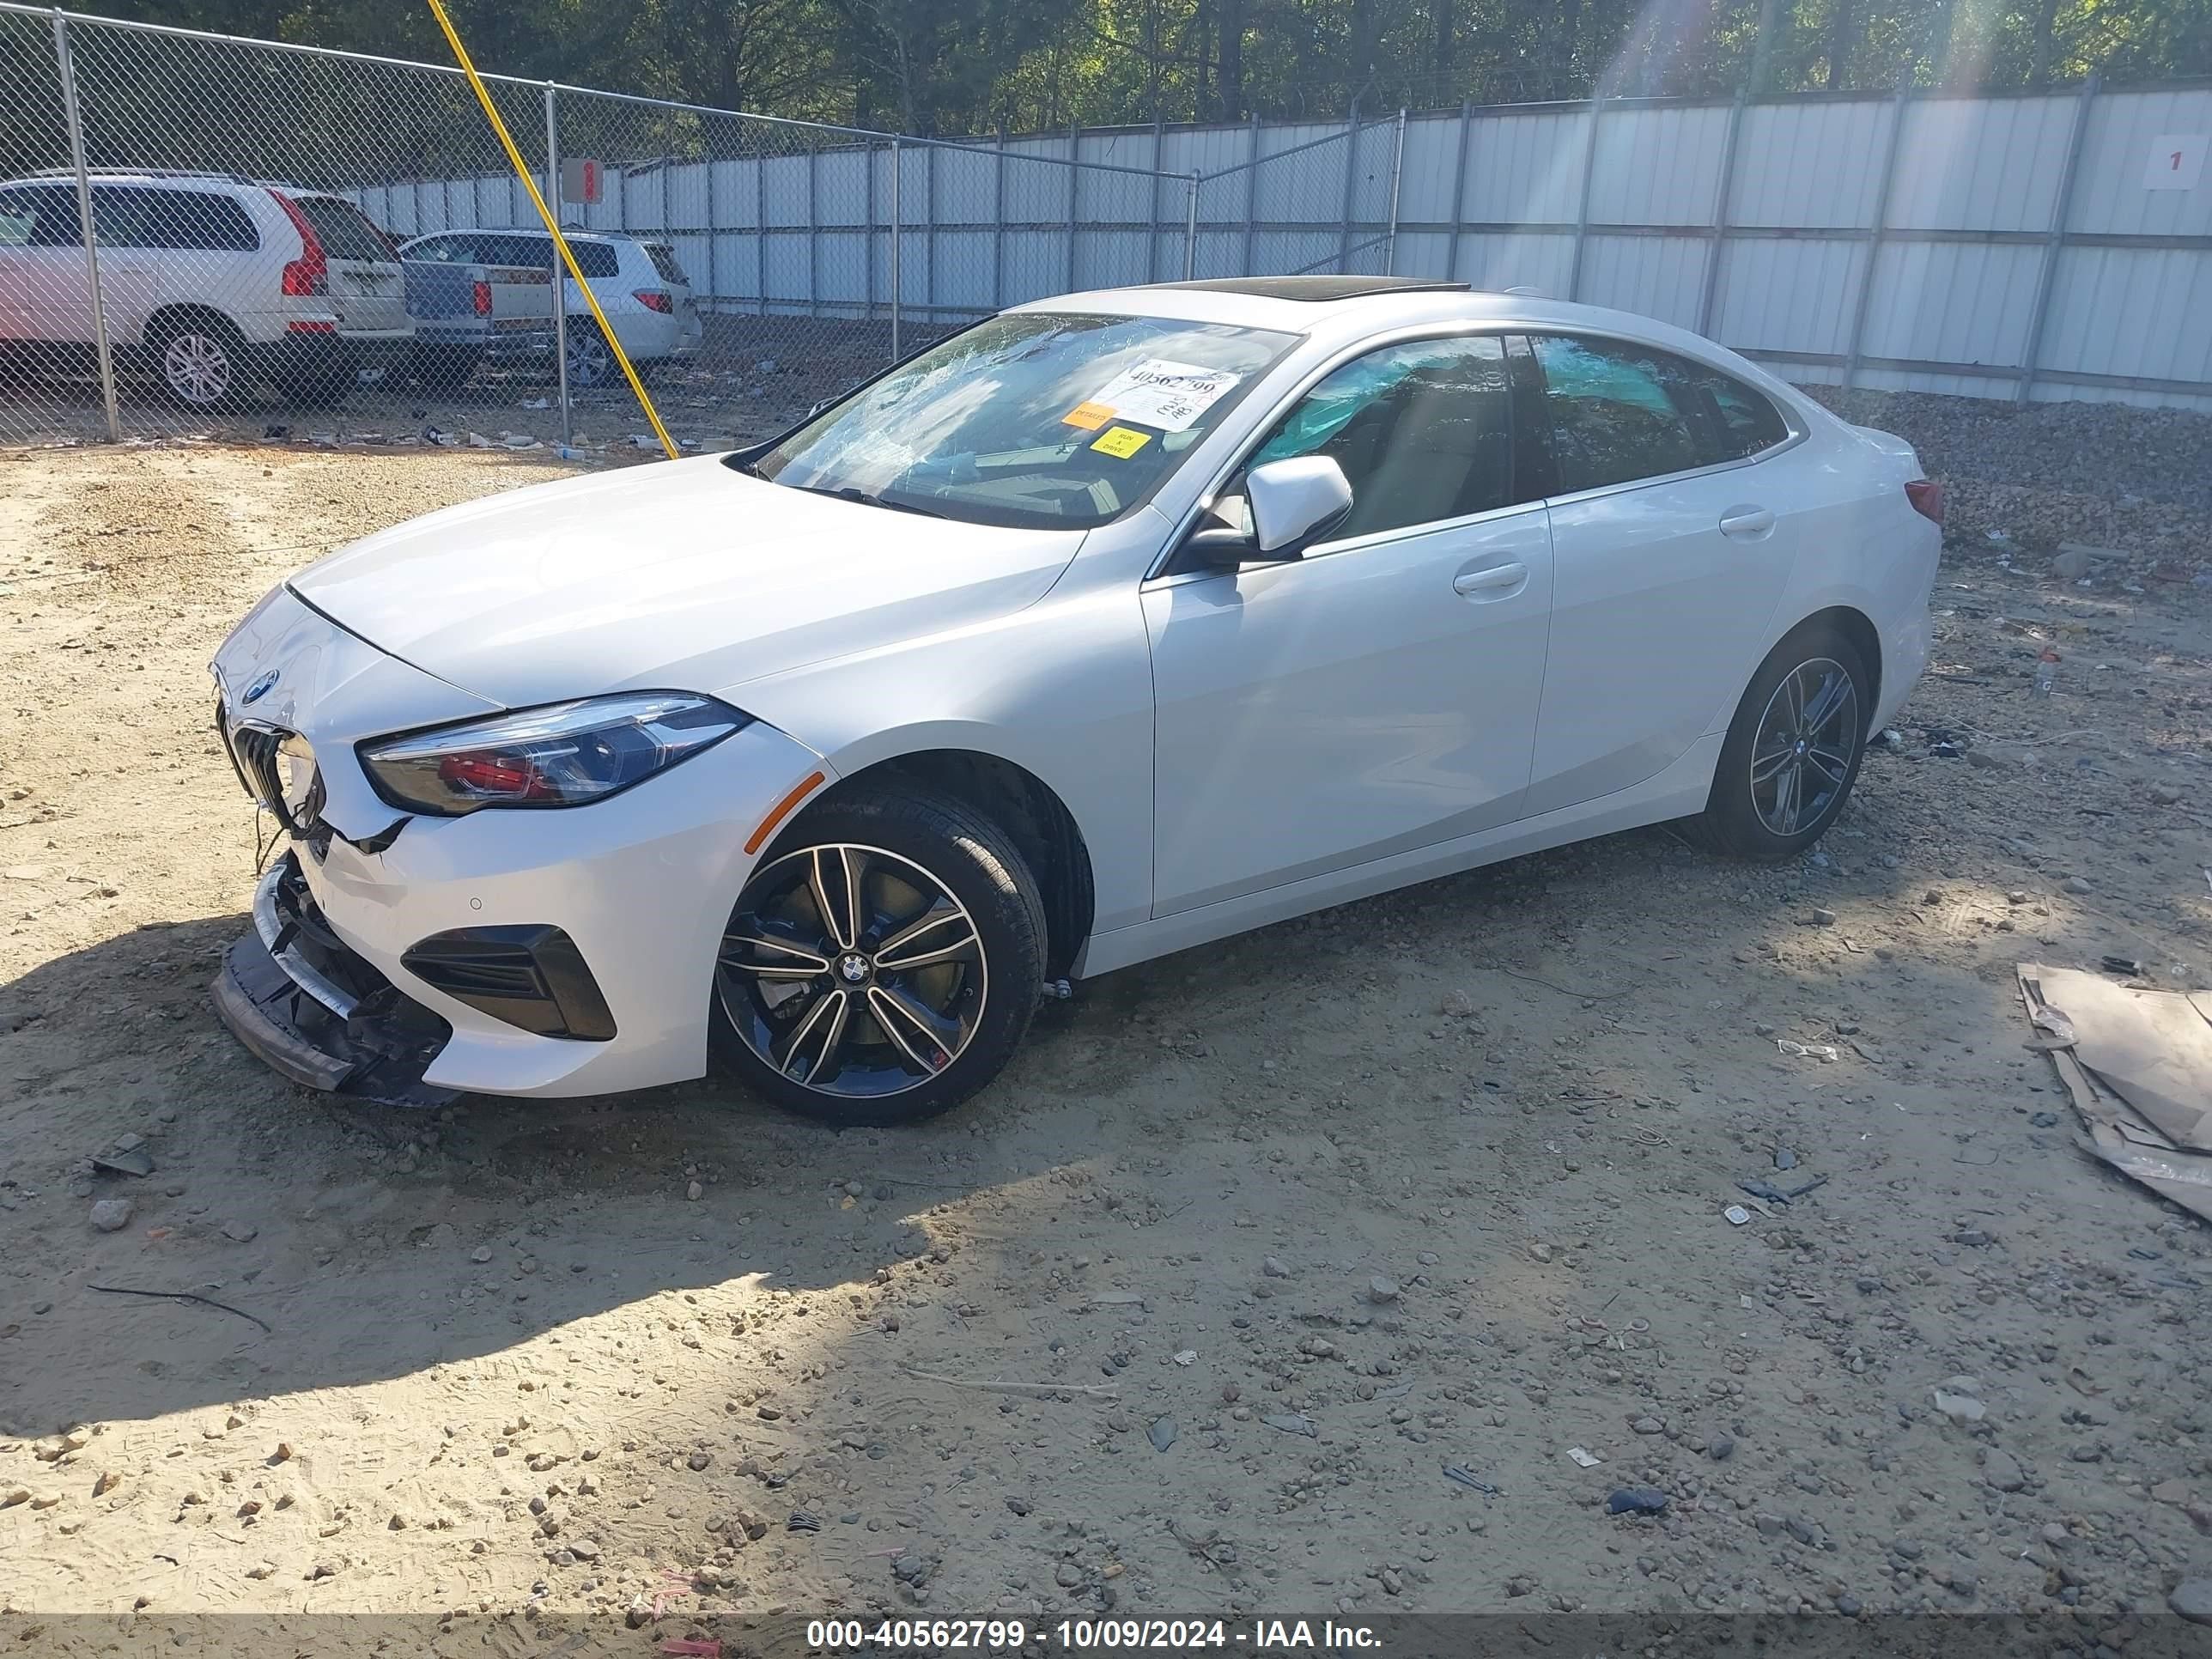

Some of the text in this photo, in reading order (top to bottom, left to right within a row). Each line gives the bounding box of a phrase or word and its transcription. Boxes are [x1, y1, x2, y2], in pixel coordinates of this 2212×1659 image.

[2170, 151, 2182, 171] 1
[1075, 410, 1107, 421] DETAILED
[1118, 433, 1134, 441] RUN
[1103, 443, 1125, 453] DRIVE
